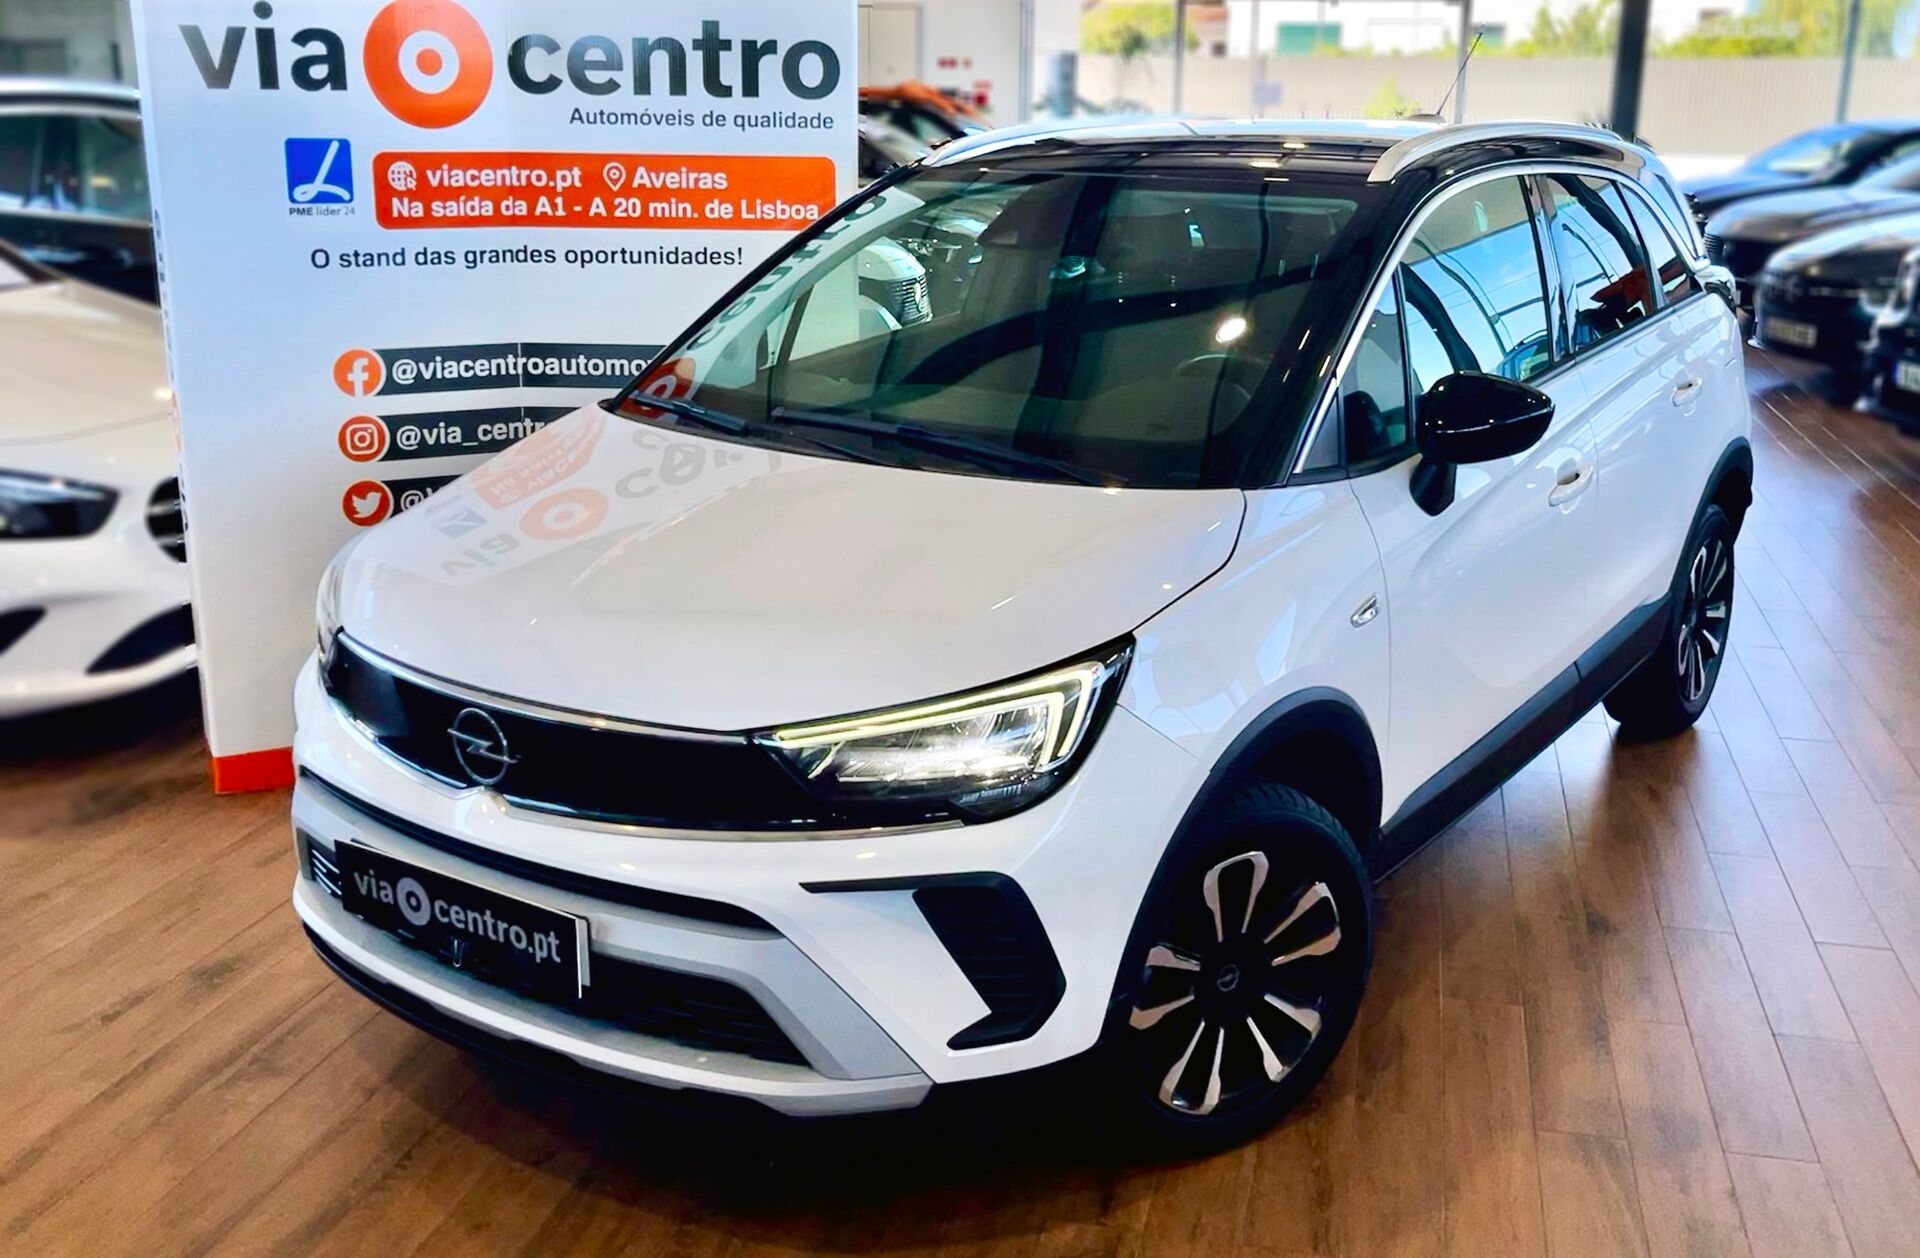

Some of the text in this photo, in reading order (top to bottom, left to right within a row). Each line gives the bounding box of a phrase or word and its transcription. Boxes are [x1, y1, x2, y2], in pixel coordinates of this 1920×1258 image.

[178, 1, 841, 101] via centro
[569, 107, 834, 131] Automóveis de qualidade
[425, 163, 728, 192] viacentro.pt Aveiras
[288, 206, 314, 216] PME
[391, 196, 424, 219] Na
[430, 195, 494, 217] saída
[500, 196, 529, 217] da
[534, 196, 567, 217] A1
[588, 197, 607, 218] A
[613, 198, 642, 219] 20
[649, 198, 699, 219] min.
[704, 200, 734, 220] de
[741, 199, 819, 221] Lisboa
[311, 245, 743, 269] O stand das grandes oportunidades!
[391, 354, 652, 385] @viacentroautomo
[353, 869, 561, 964] via centro.pt
